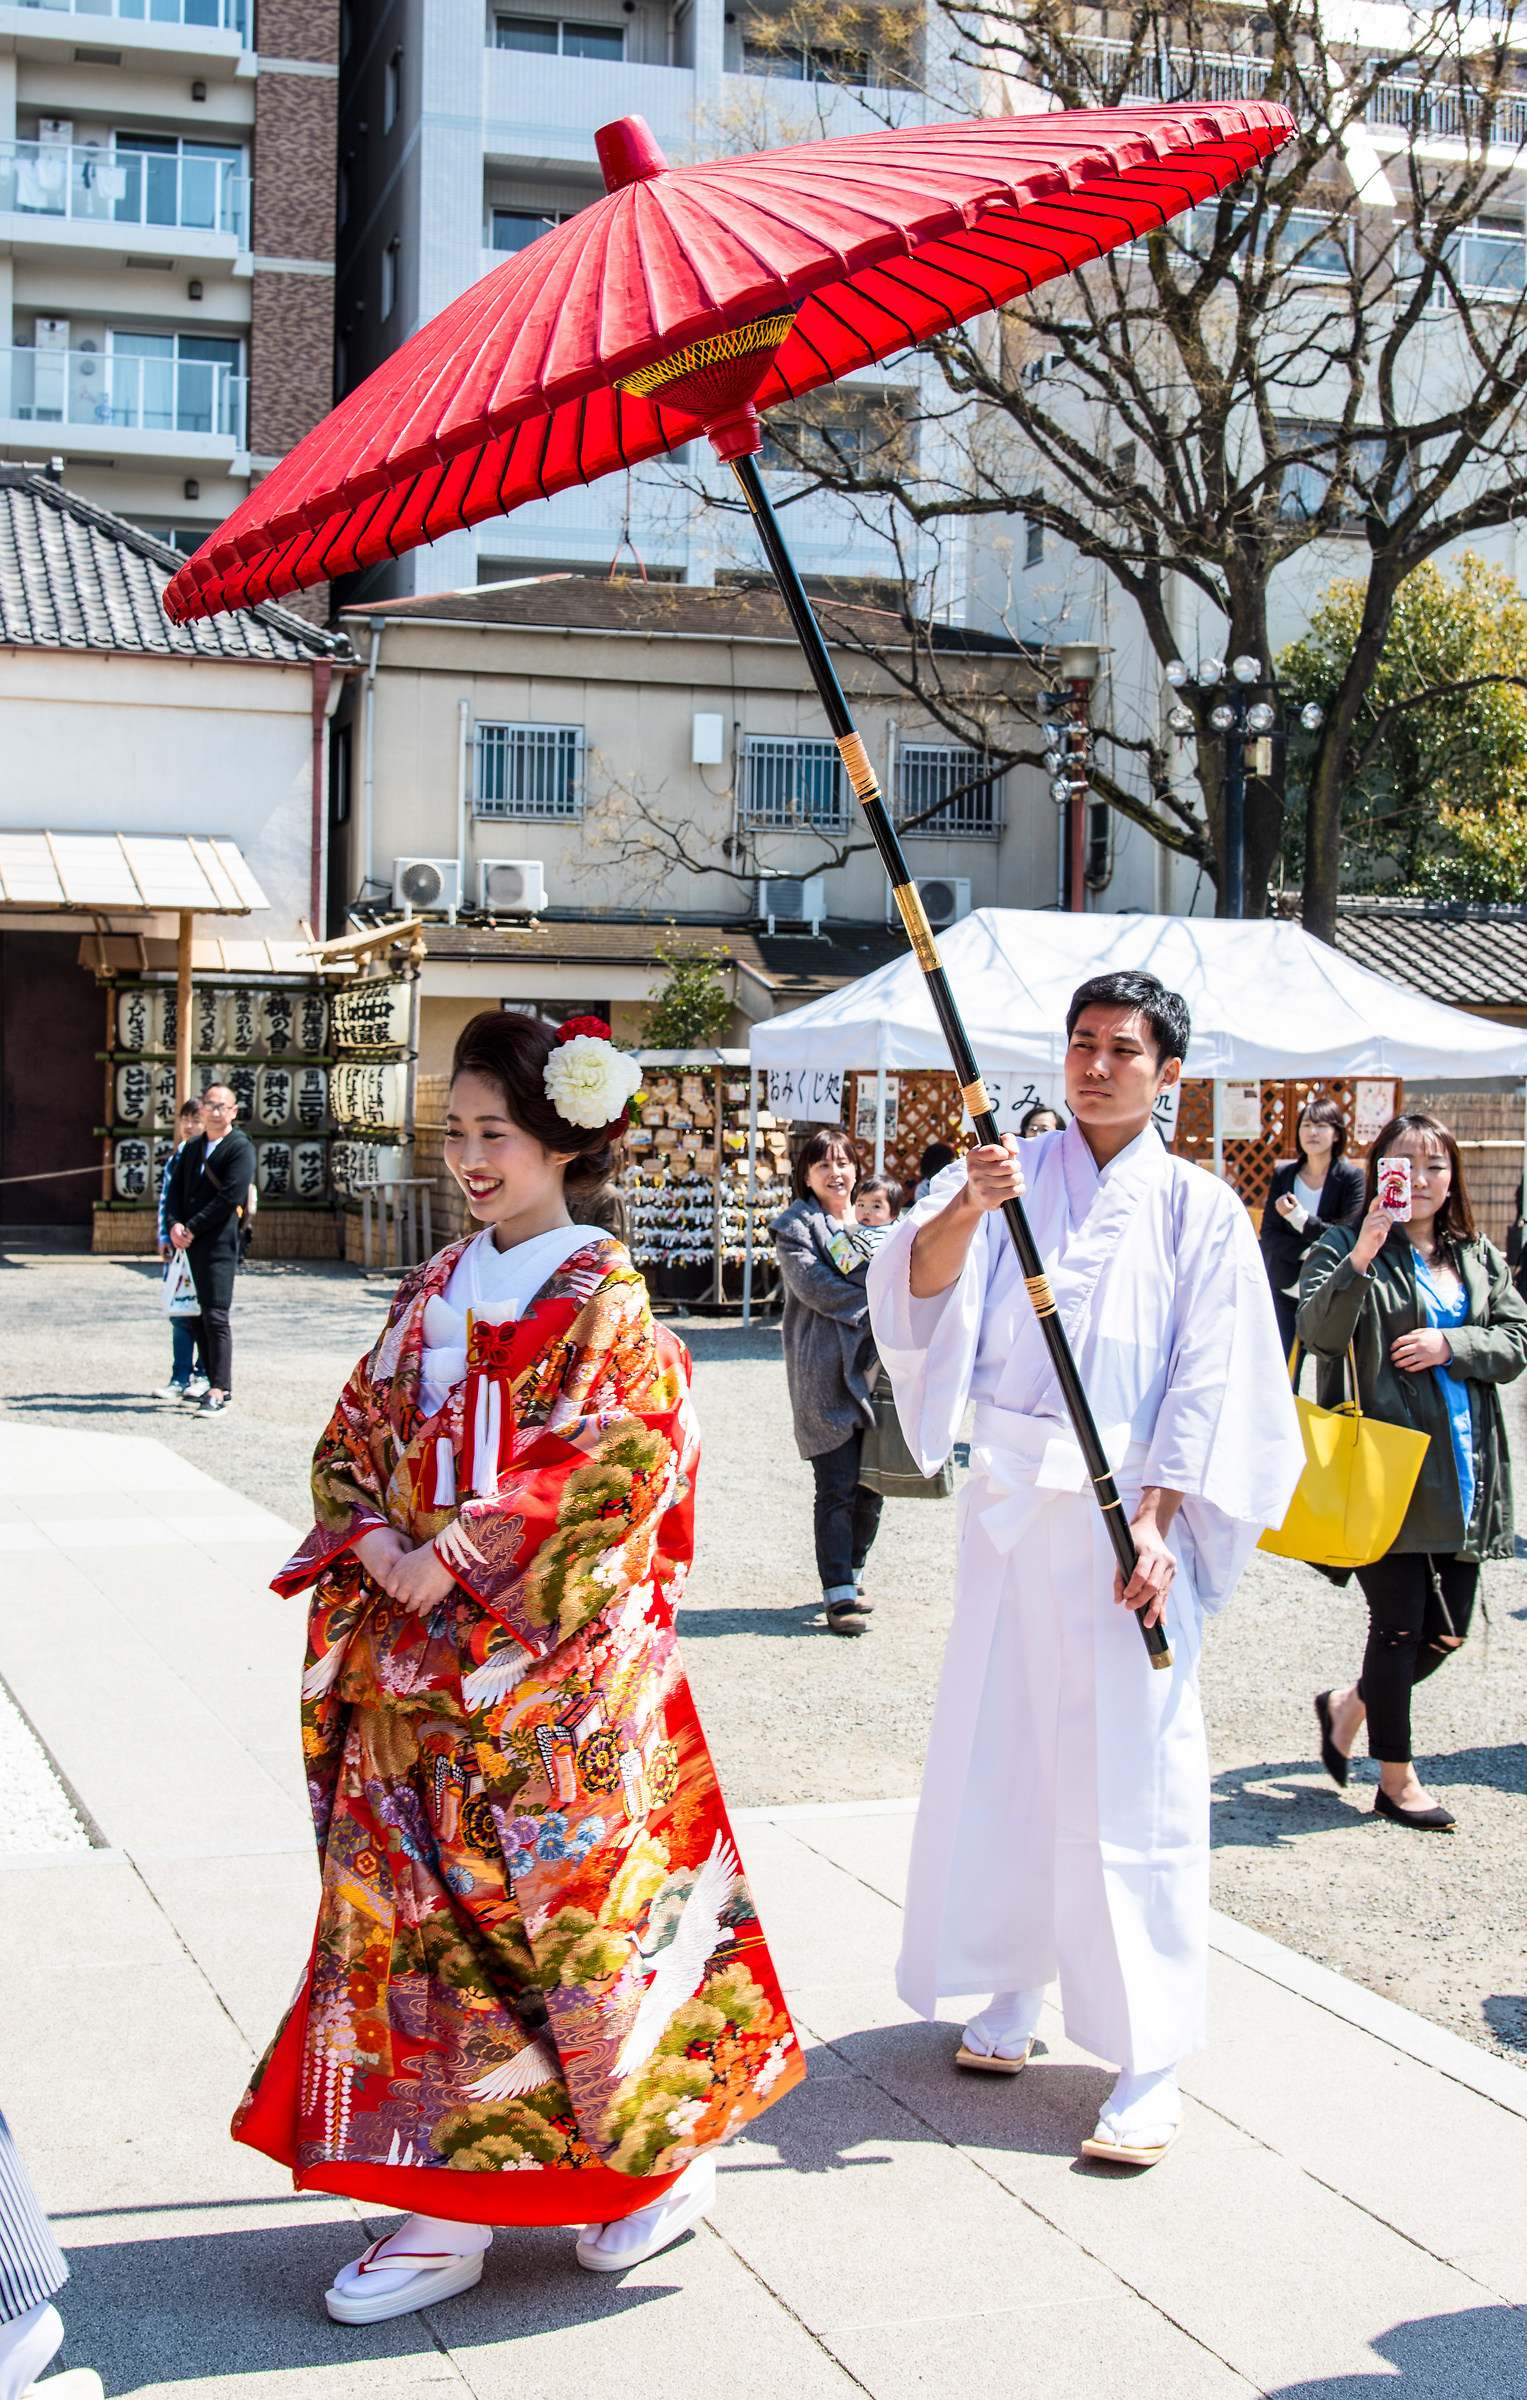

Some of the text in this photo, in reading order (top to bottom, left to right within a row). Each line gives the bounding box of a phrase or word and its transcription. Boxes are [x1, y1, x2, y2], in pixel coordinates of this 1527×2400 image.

[770, 1069, 840, 1104] おみくじ処
